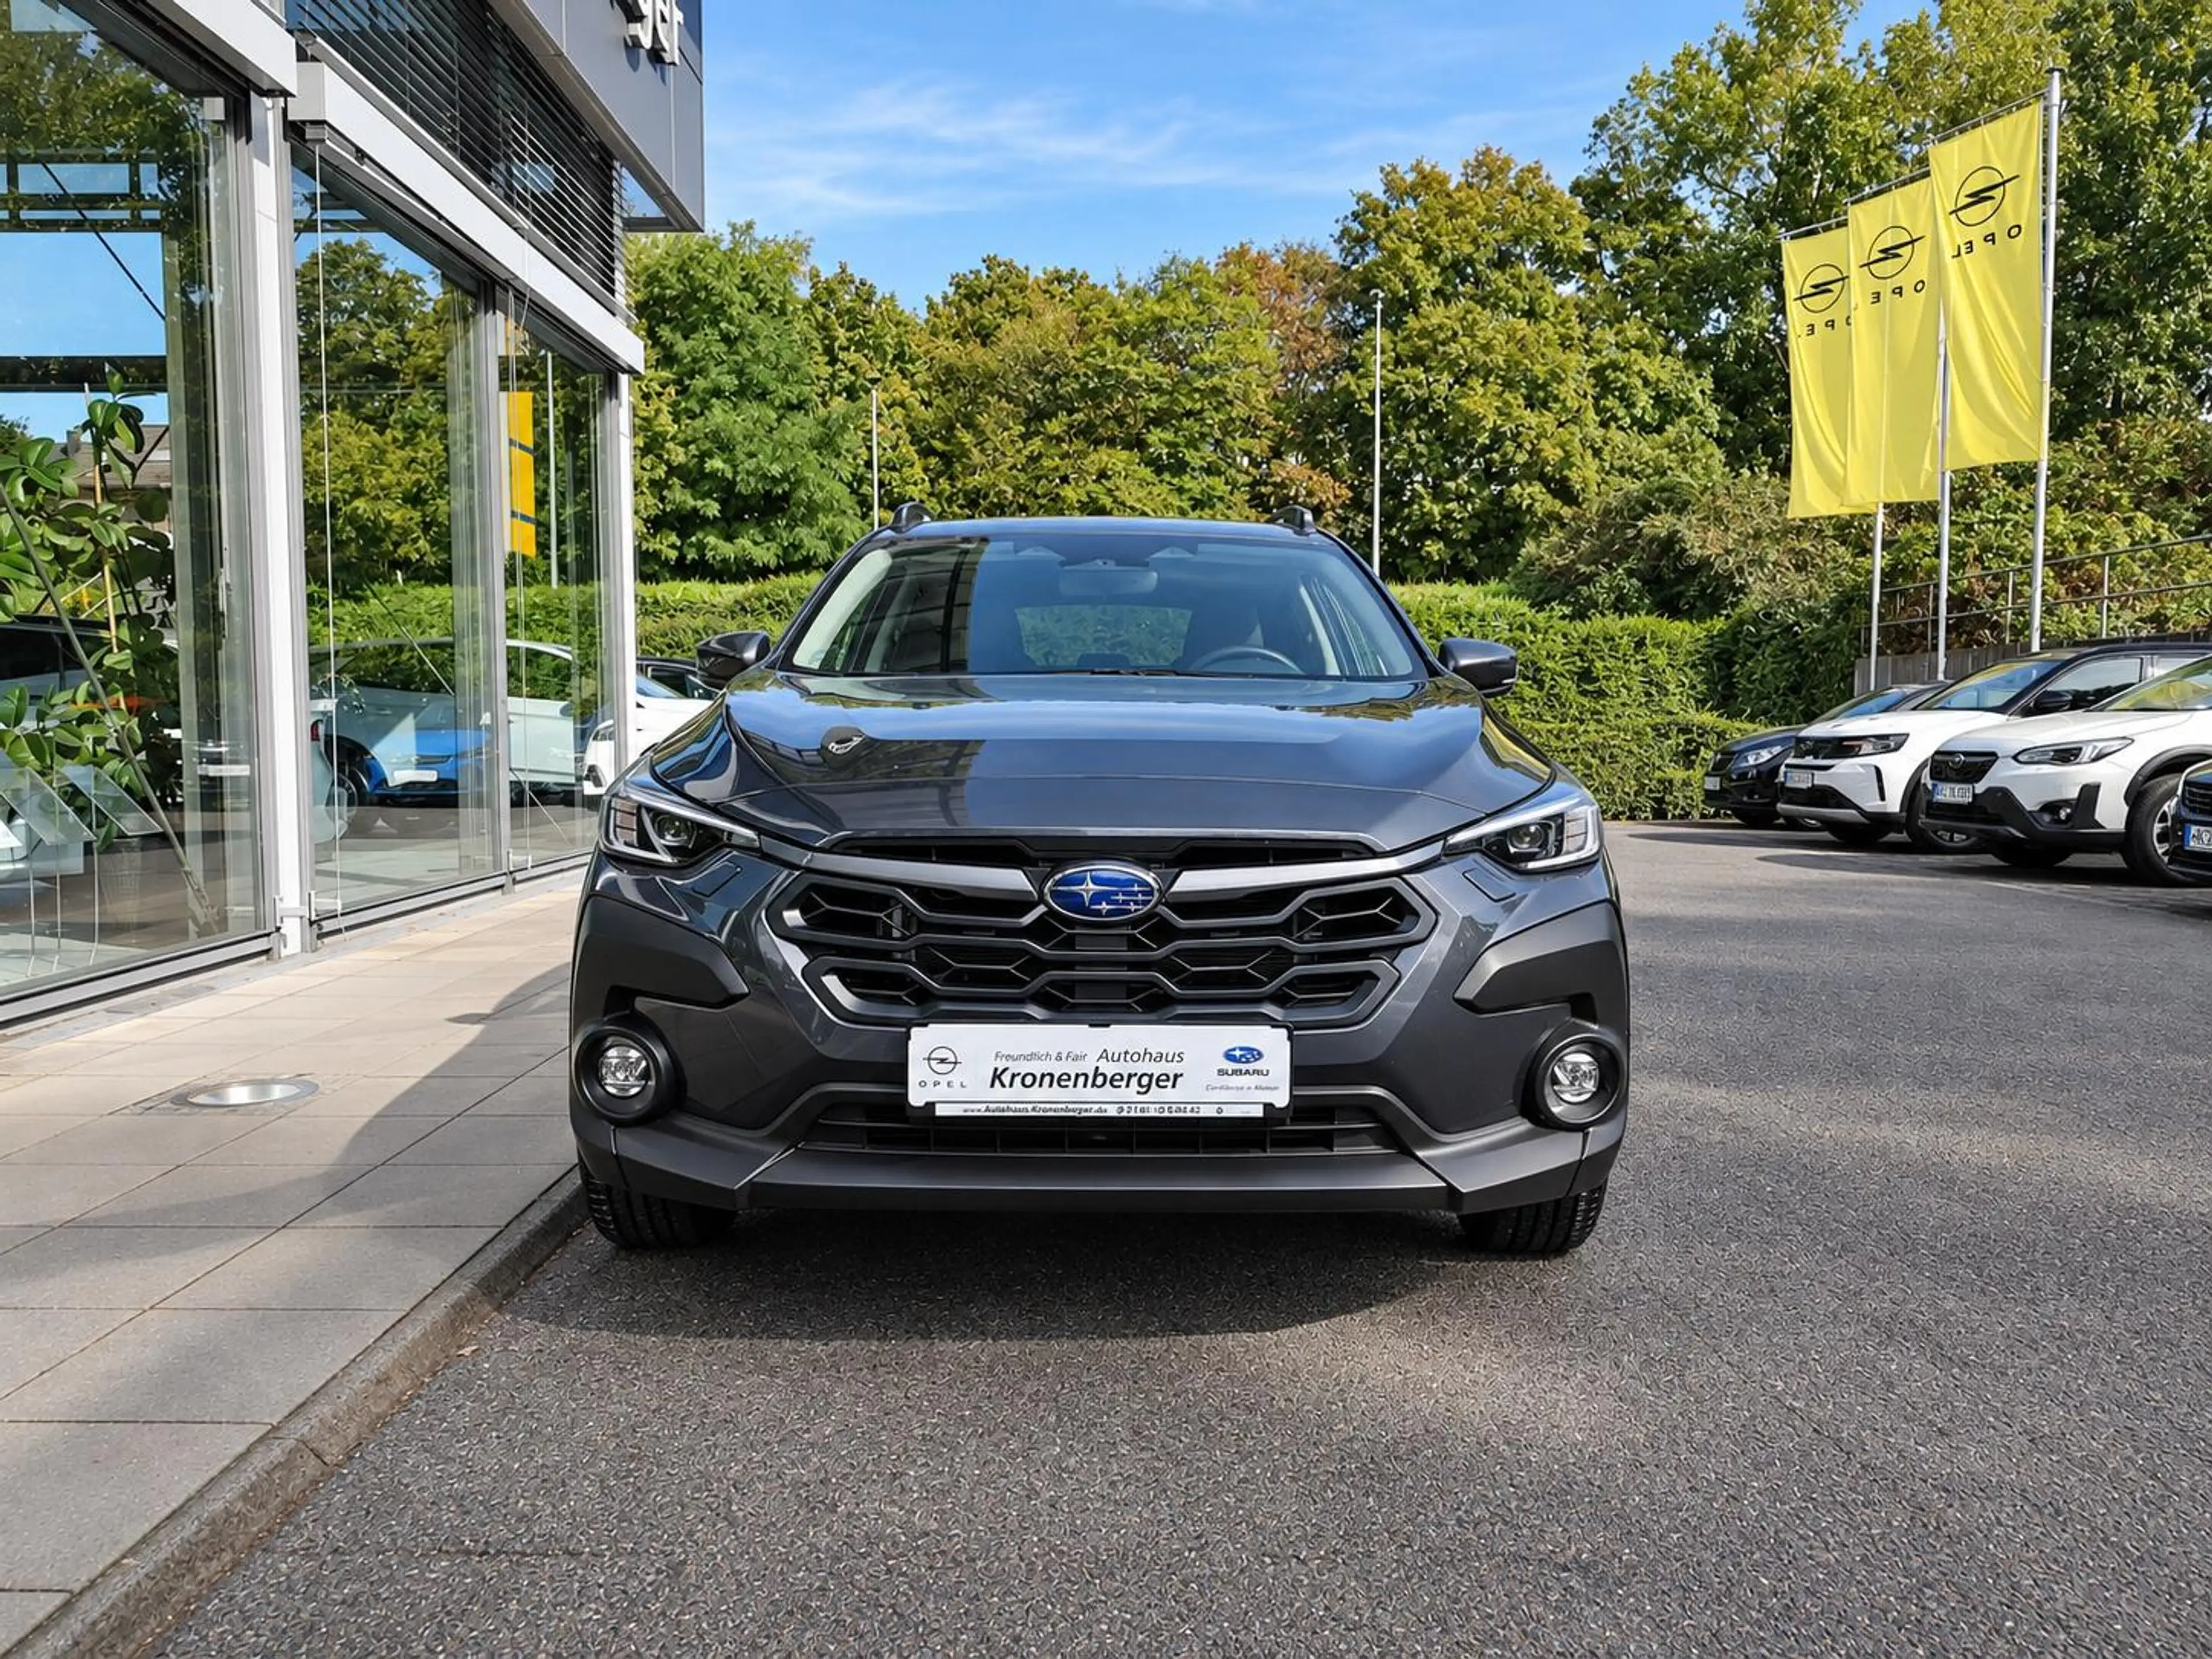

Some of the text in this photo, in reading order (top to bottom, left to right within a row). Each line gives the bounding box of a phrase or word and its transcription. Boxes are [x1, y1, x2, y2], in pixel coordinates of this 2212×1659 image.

[994, 1047, 1185, 1063] Freundlich & Fair Autohaus
[1217, 1067, 1270, 1077] SUBARU
[918, 1080, 967, 1089] OPEL
[989, 1066, 1184, 1095] Kronenberger
